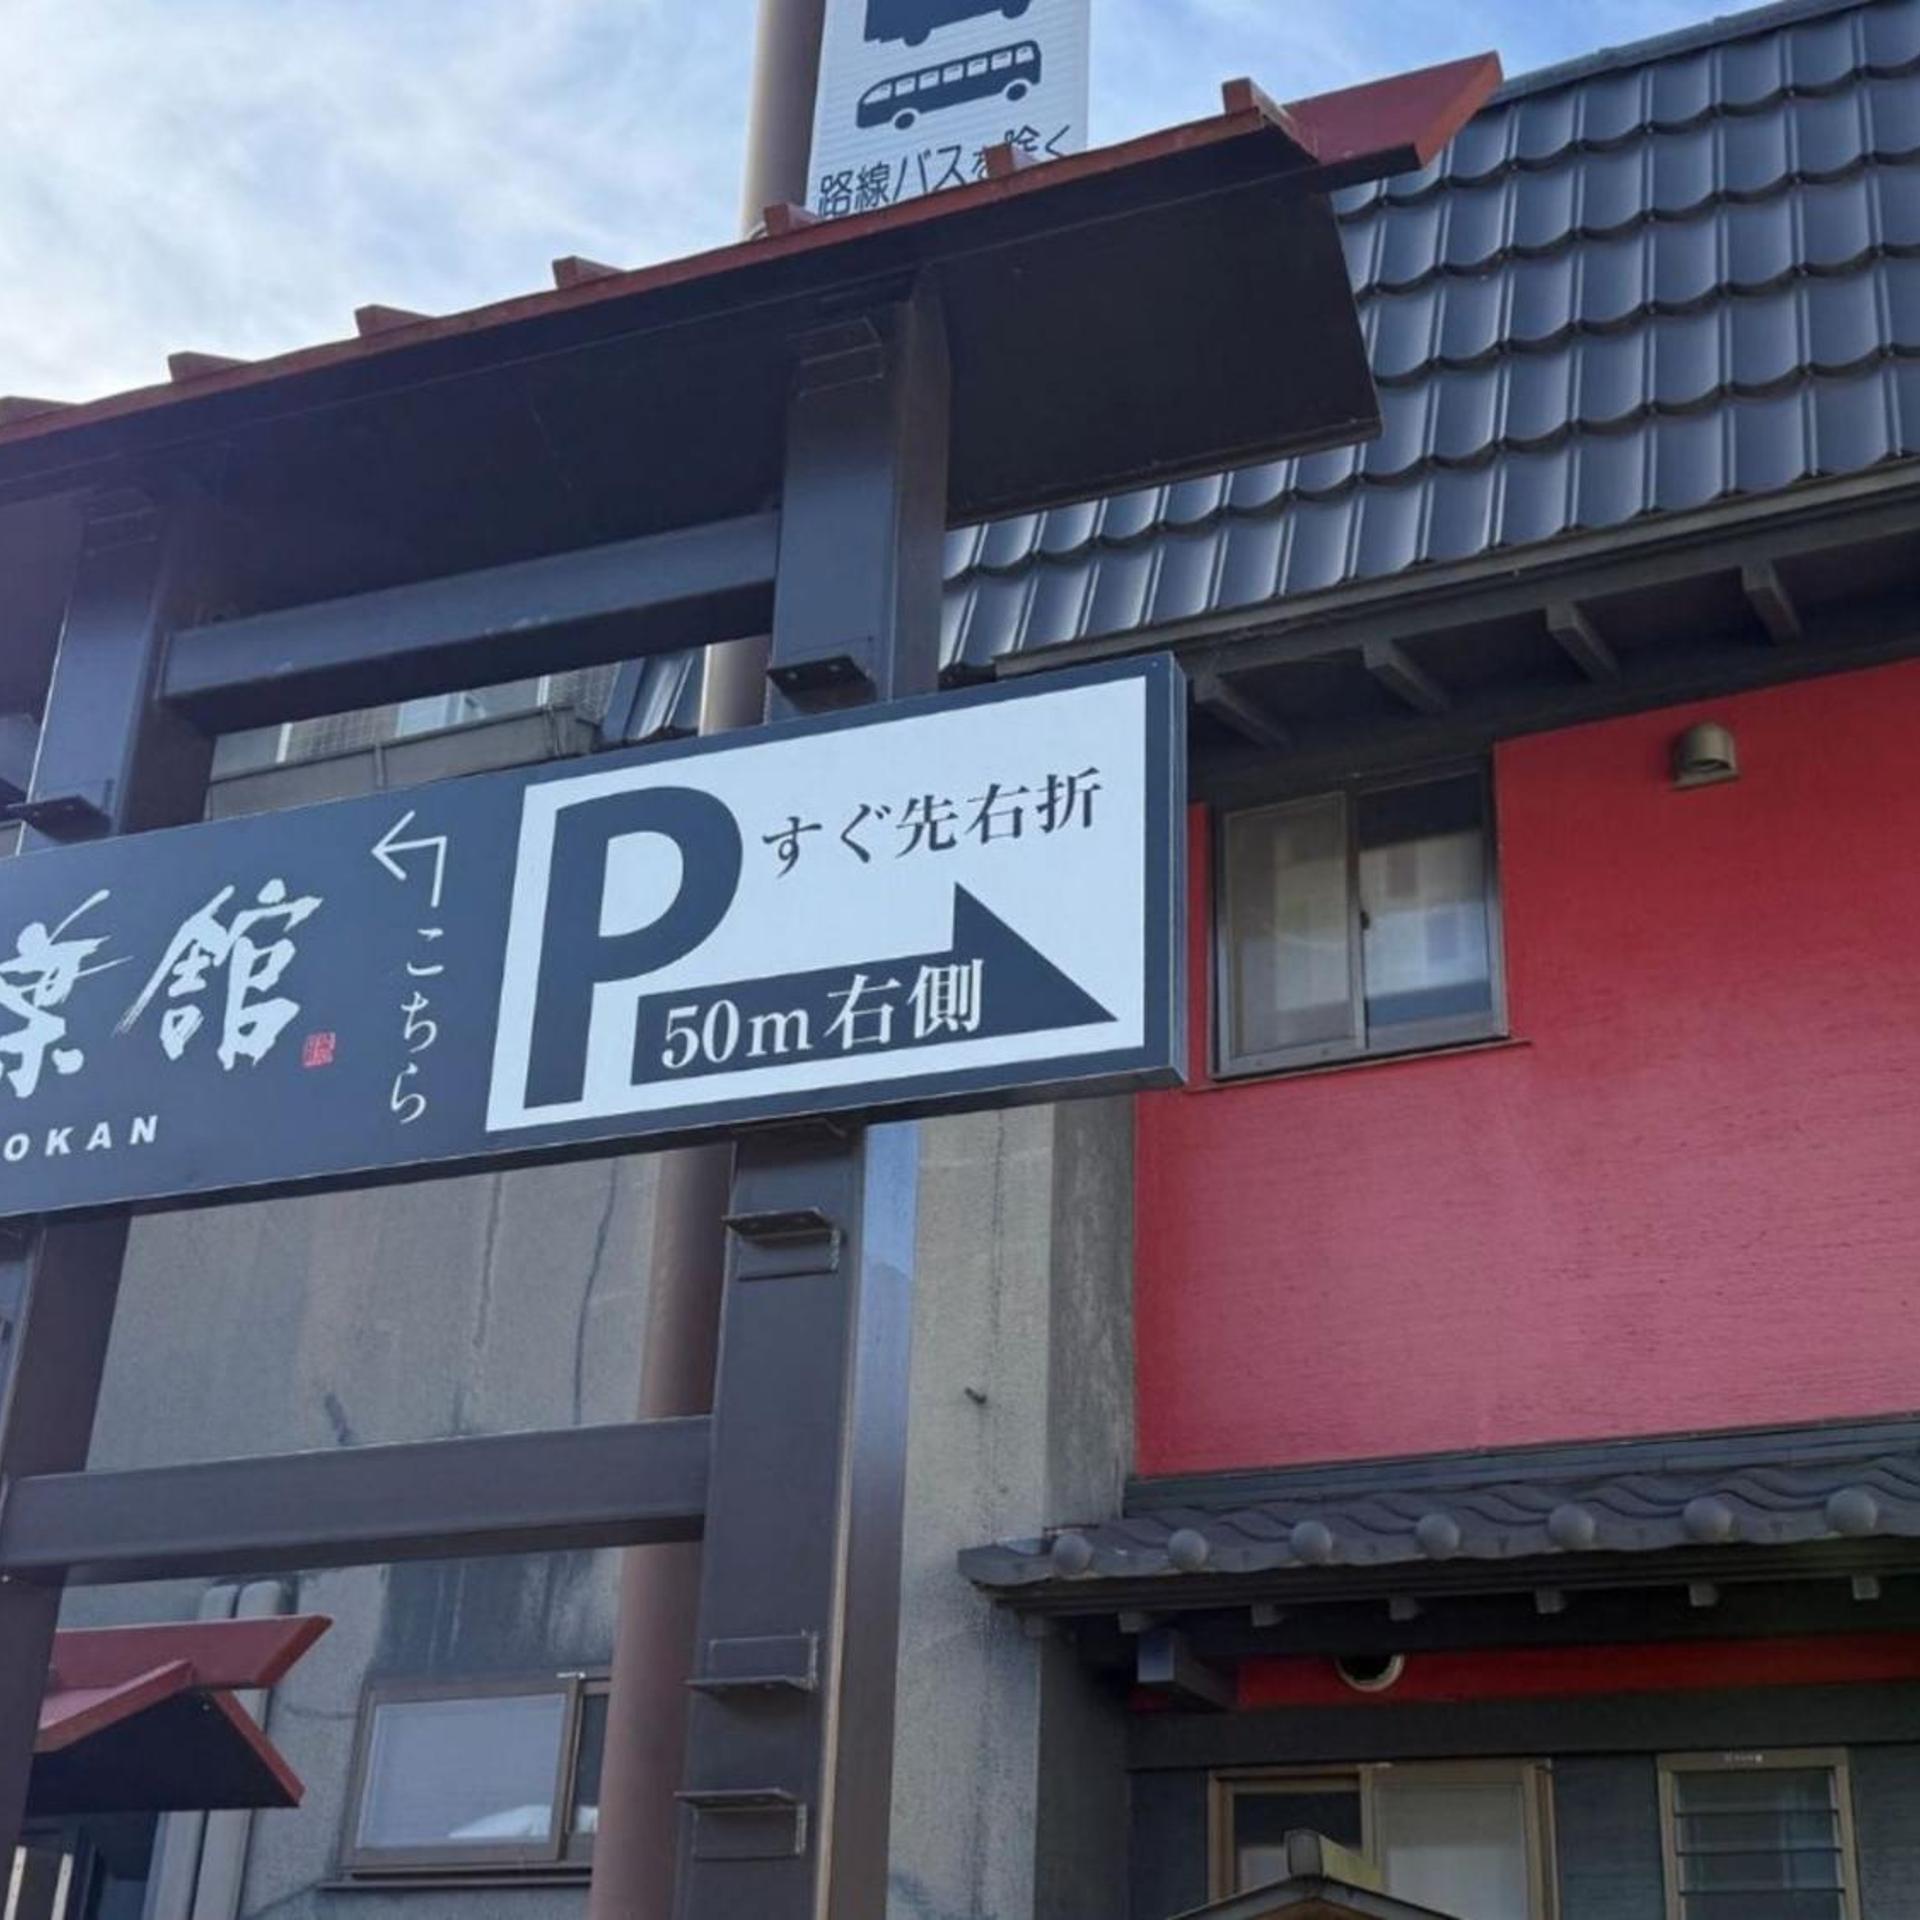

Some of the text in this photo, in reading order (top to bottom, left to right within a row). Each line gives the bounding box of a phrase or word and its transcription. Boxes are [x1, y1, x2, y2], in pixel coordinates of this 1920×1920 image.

[761, 766, 1103, 879] すぐ先右折
[523, 785, 743, 1109] P
[391, 928, 445, 1124] こちら
[661, 958, 983, 1069] 50m右側
[3, 1114, 158, 1162] OKAN
